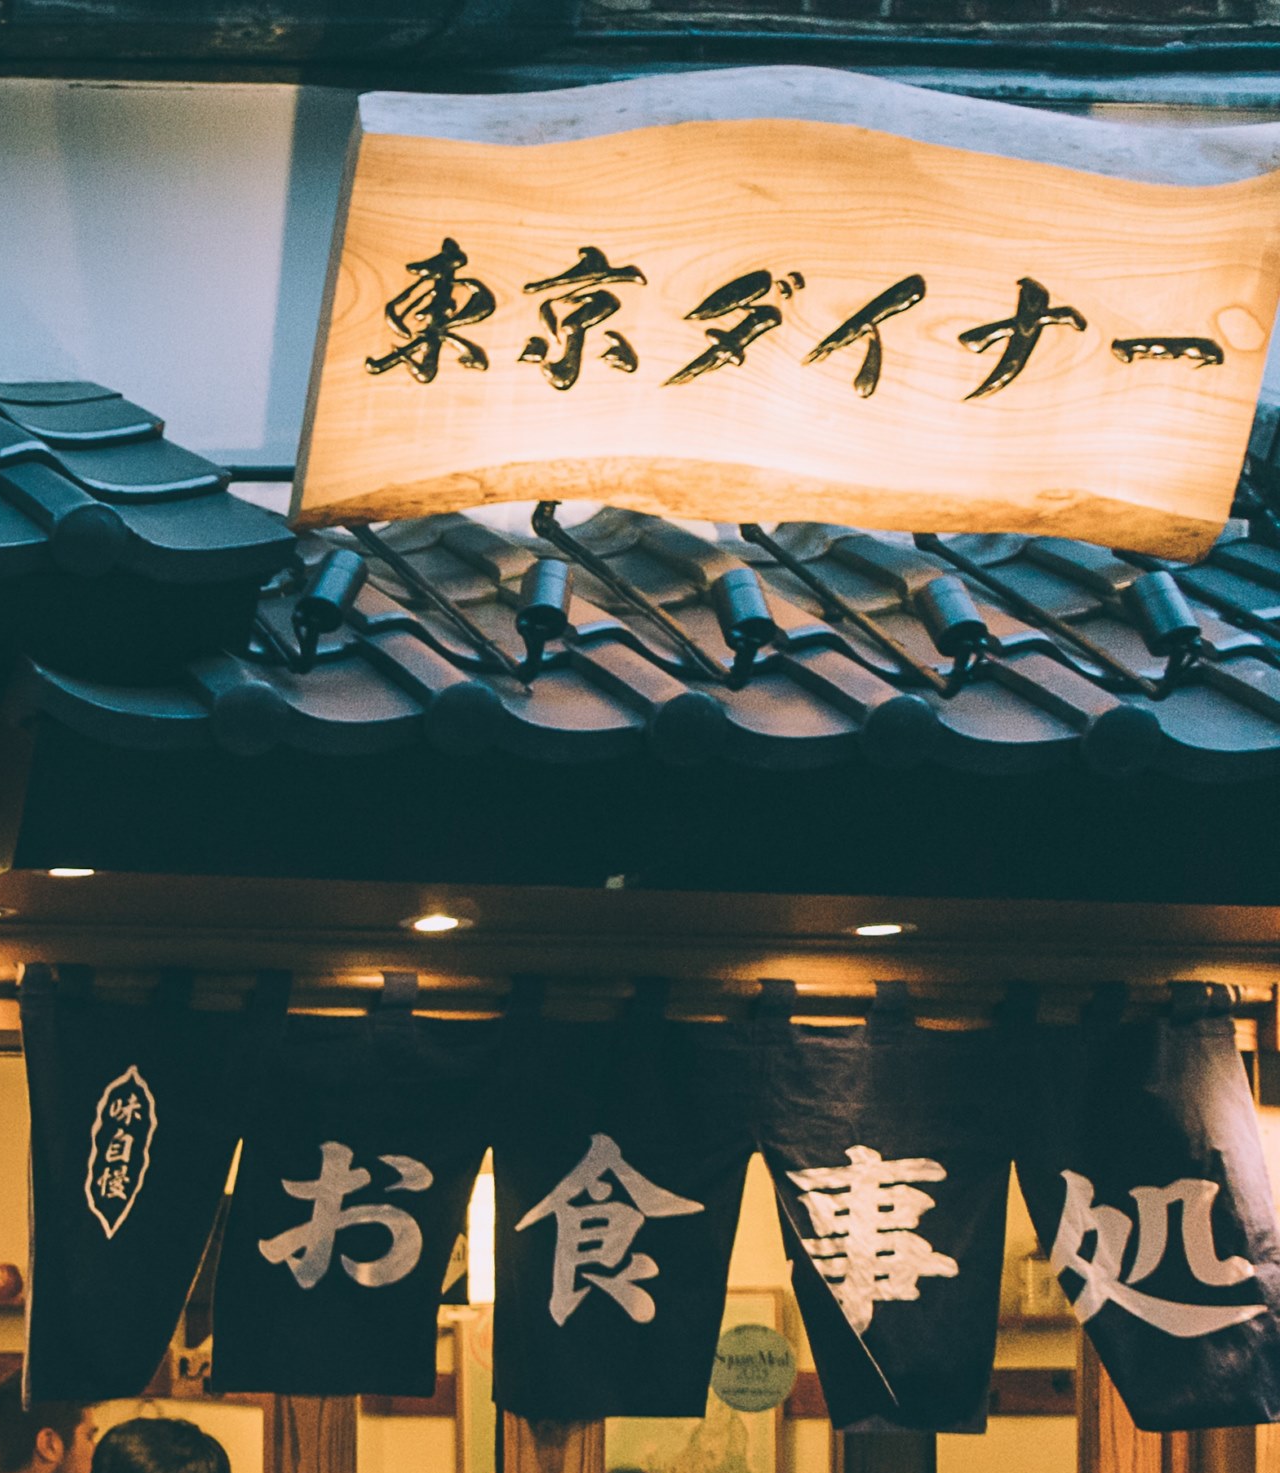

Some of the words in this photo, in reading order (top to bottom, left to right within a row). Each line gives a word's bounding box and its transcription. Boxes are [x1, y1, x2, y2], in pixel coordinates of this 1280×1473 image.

[364, 237, 1225, 401] 東京ダイナー
[97, 1092, 142, 1201] 味自慢
[259, 1133, 1269, 1338] お食事処
